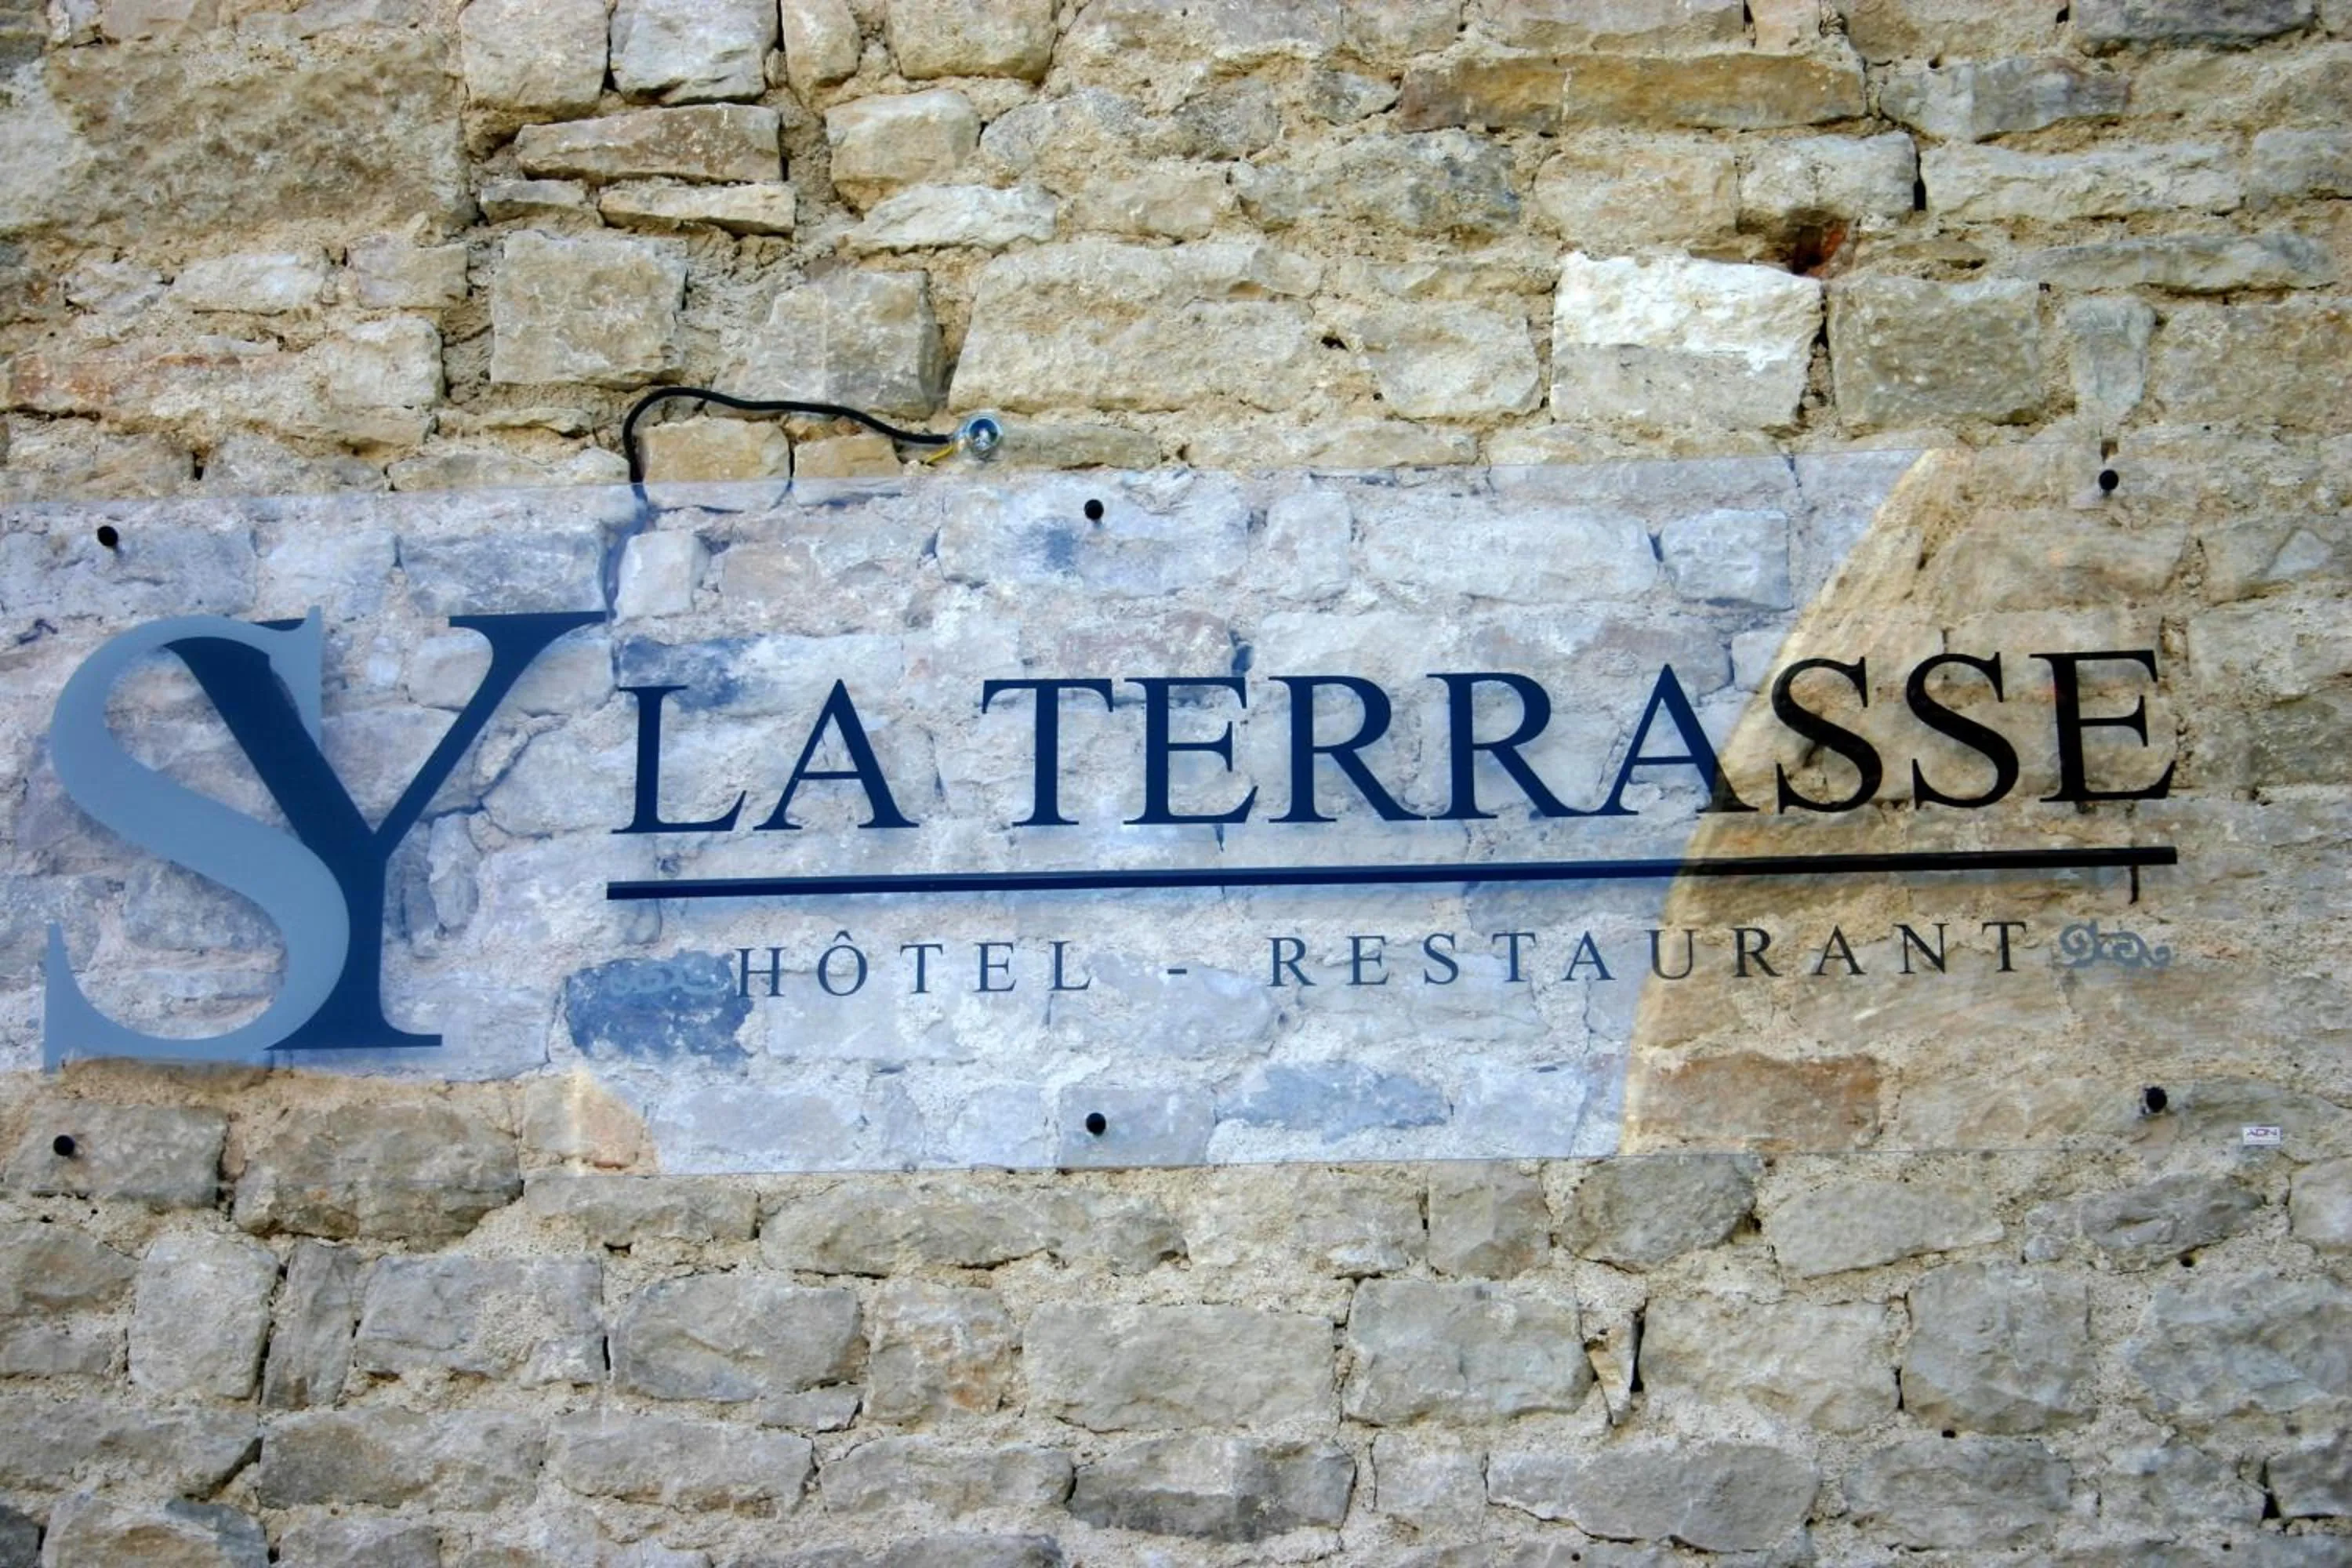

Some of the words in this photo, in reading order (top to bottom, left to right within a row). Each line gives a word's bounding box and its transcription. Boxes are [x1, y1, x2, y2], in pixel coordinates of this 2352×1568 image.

[612, 678, 920, 834] LA
[981, 650, 2176, 826] TERRASSE
[43, 605, 607, 1074] SY
[734, 931, 1092, 998] HÔTEL
[1269, 920, 2027, 988] RESTAURANT
